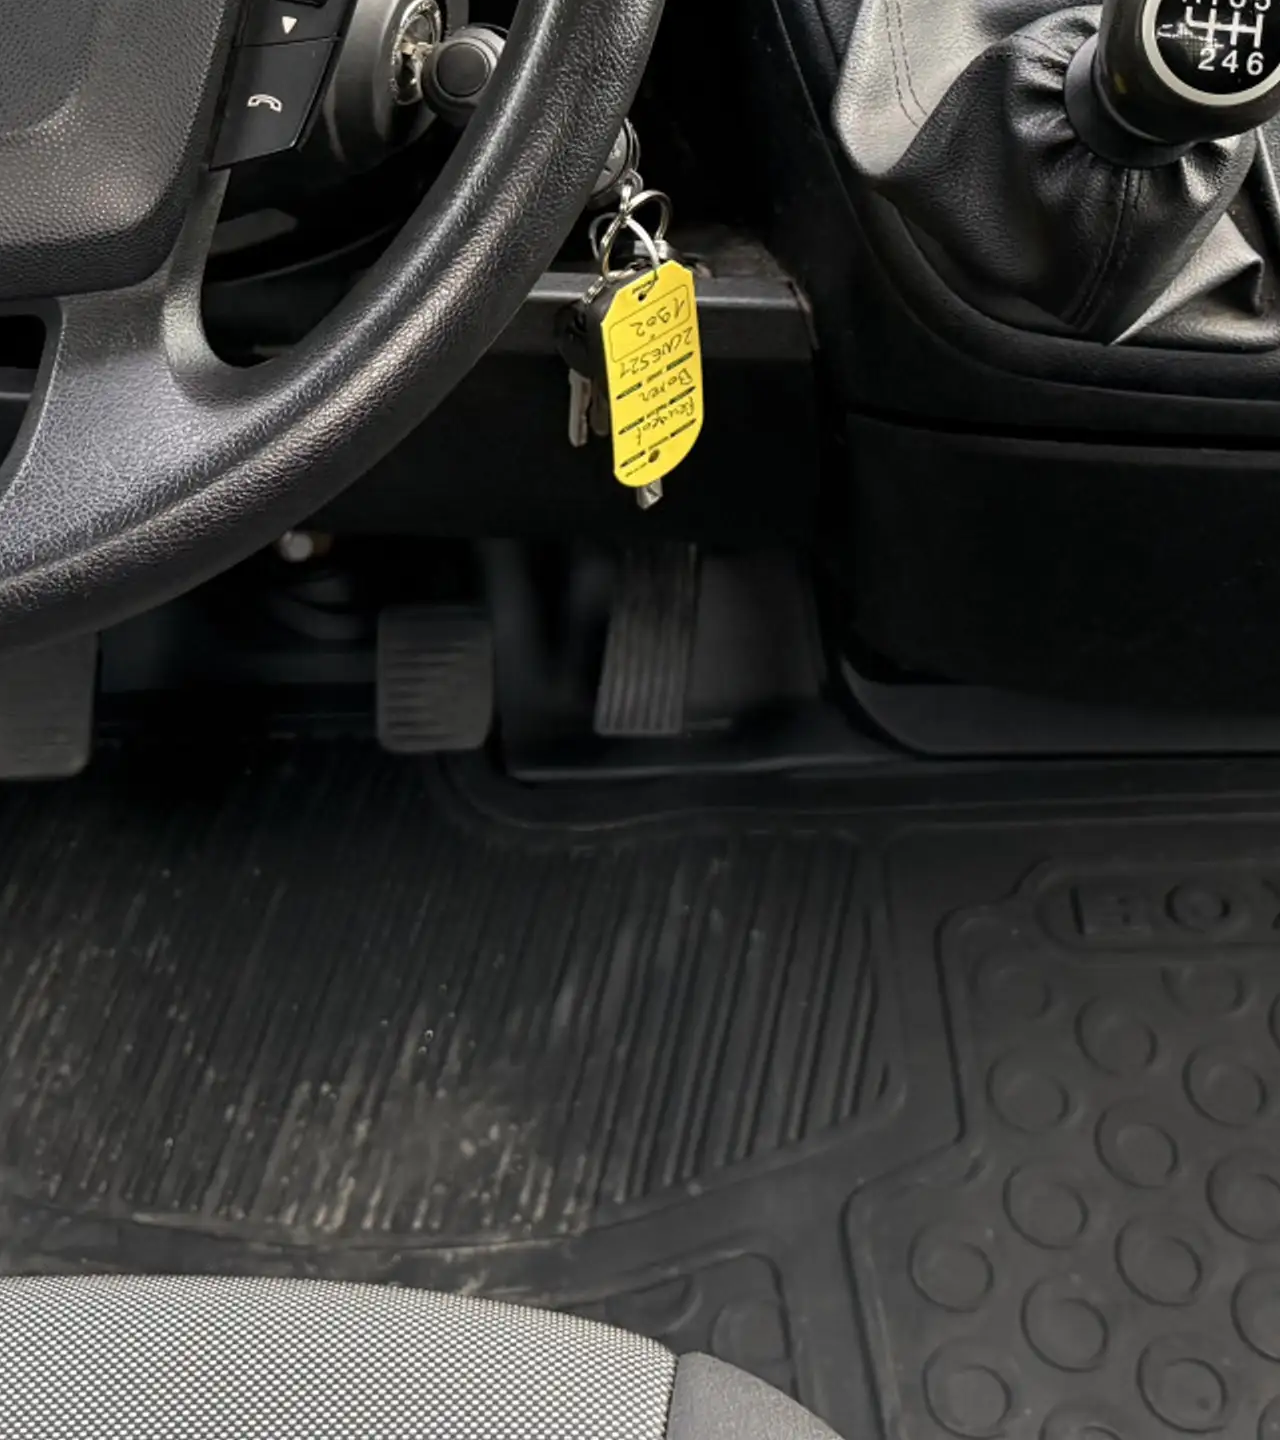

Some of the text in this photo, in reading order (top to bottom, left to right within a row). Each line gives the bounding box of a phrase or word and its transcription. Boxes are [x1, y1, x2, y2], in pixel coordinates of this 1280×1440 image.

[1198, 47, 1264, 76] 2 4 6
